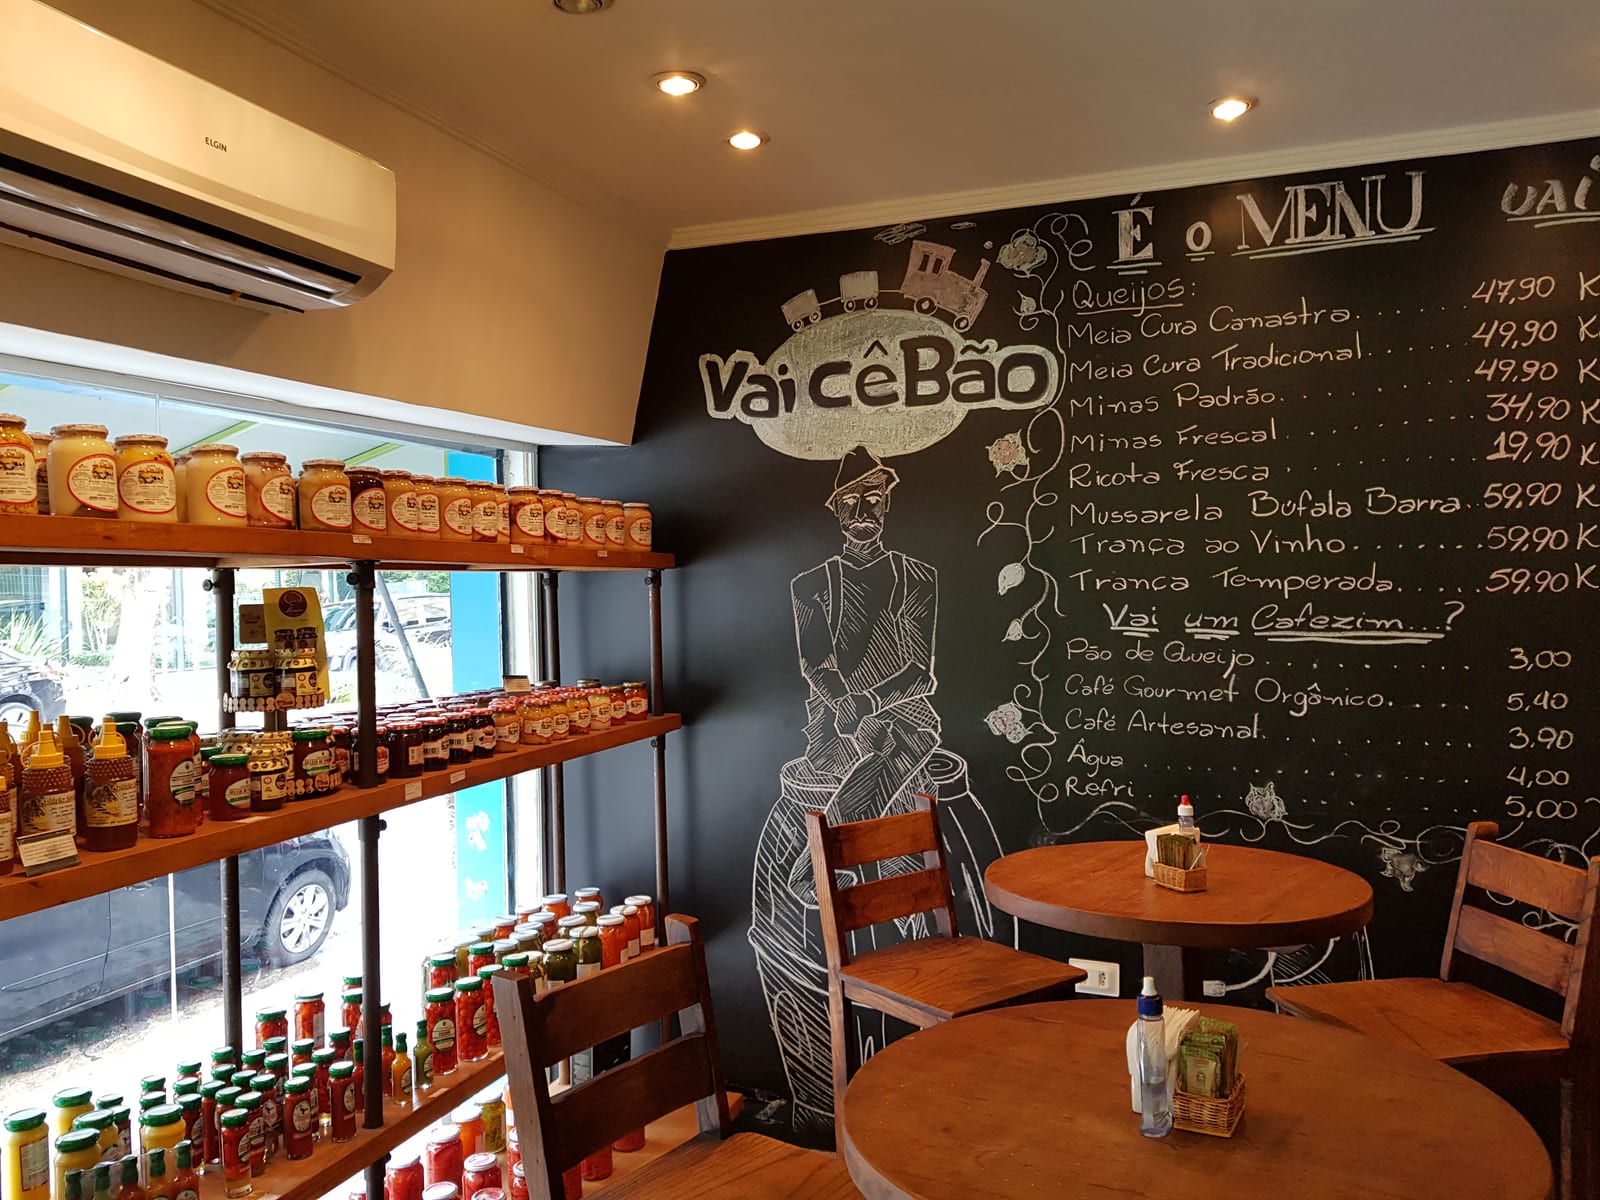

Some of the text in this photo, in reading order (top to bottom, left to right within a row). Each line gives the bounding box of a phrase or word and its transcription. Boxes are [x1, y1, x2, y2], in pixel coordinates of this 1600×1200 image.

[204, 136, 228, 153] ELGIN
[1111, 193, 1155, 264] É
[1236, 171, 1427, 249] MENU
[1068, 322, 1132, 349] Meia
[1140, 313, 1198, 338] Cura
[1208, 296, 1351, 332] Canastra
[1471, 275, 1556, 305] 47,90
[1072, 278, 1197, 318] Queijos:
[1069, 359, 1133, 383] Meia
[1142, 354, 1202, 377] Cura
[1210, 331, 1362, 372] Tradicional
[1471, 319, 1558, 350] 49,90
[1069, 395, 1160, 418] Minas
[1172, 382, 1276, 408] Padrão
[1473, 357, 1559, 383] 49,90
[1070, 433, 1163, 454] Minas
[1175, 417, 1277, 446] Frescal
[1486, 392, 1571, 423] 34,90
[1069, 461, 1161, 489] Ricota
[1172, 458, 1270, 482] Fresca
[1485, 430, 1572, 464] 19,90
[1070, 493, 1223, 527] Mussarela
[1247, 489, 1353, 519] Búfala
[1364, 486, 1462, 516] Barra
[1483, 482, 1563, 510] 59,90
[1069, 532, 1185, 556] Trança
[1204, 538, 1240, 556] ao
[1249, 522, 1346, 554] Vinho
[1486, 525, 1570, 553] 59,90
[1211, 560, 1394, 600] Temperada
[1484, 567, 1570, 595] 59,90
[1102, 602, 1159, 628] Vai
[1184, 612, 1239, 629] um
[1065, 637, 1572, 680] Pão de Queijo 3,00
[1064, 673, 1569, 718] Café Gourmet Orgânico 5,40
[1064, 707, 1574, 750] Café Artesanal 3,90
[1064, 775, 1578, 820] Refri 5,00
[1506, 765, 1570, 789] 4,00
